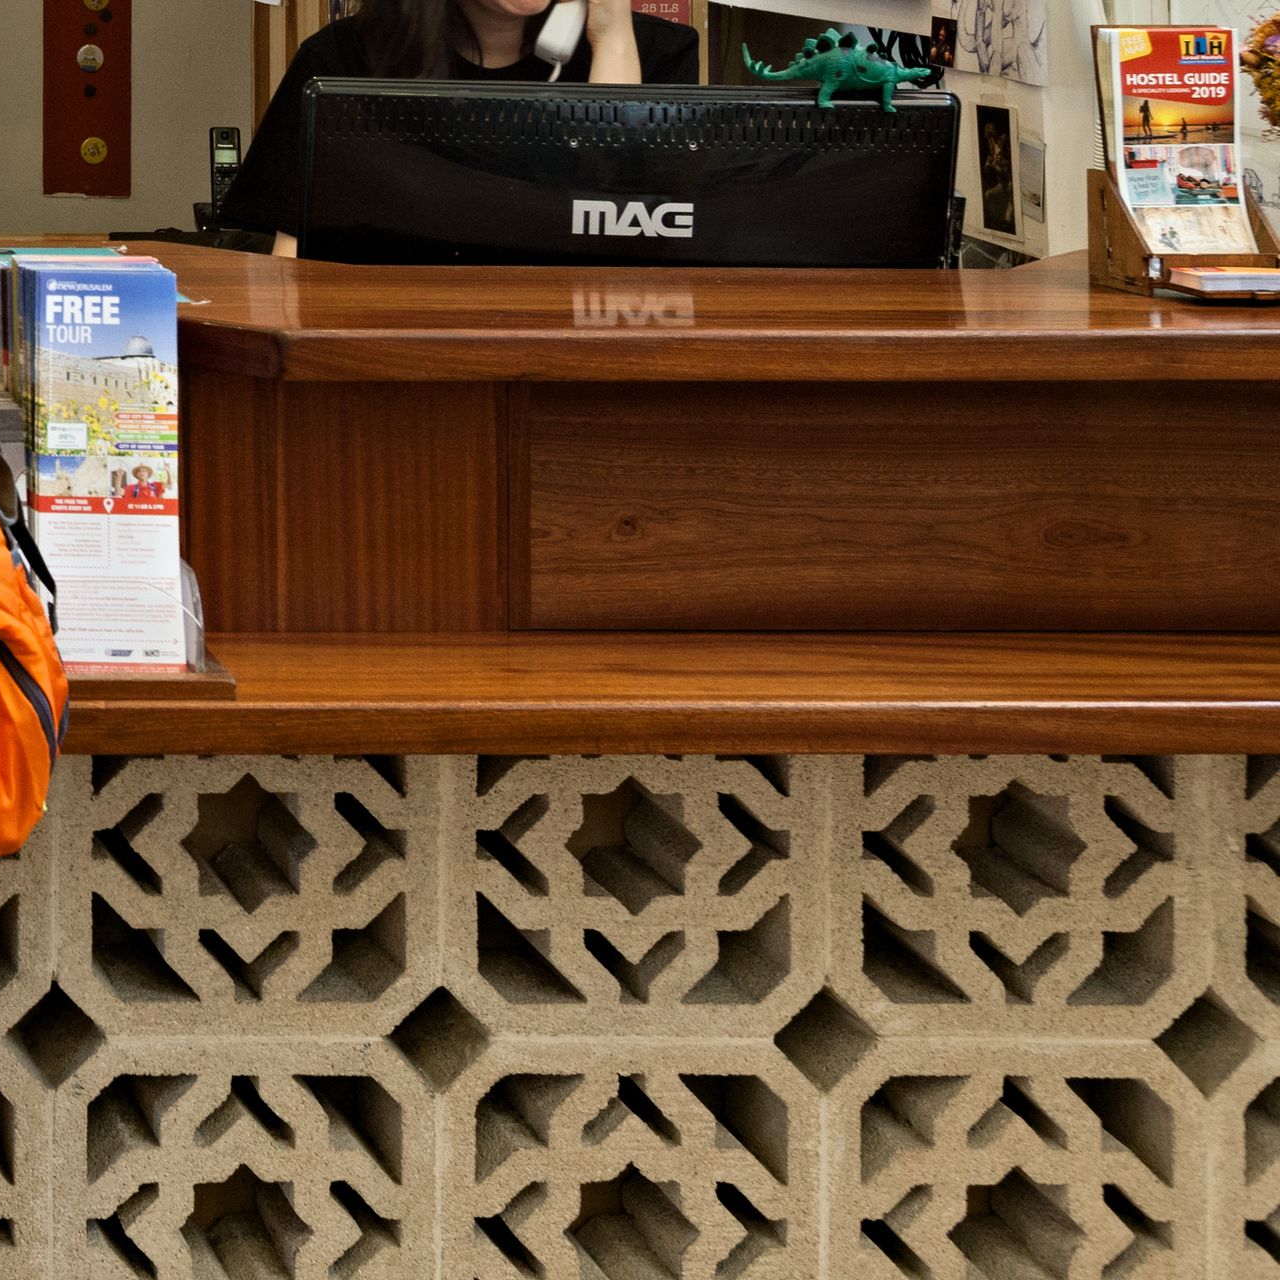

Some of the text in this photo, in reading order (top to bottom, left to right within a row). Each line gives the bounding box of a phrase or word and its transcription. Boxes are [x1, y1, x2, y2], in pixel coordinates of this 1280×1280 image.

[659, 3, 679, 13] ILS
[1126, 73, 1230, 85] HOSTEL GUIDE
[1191, 86, 1226, 98] 2019
[572, 199, 694, 238] MAG
[46, 295, 120, 324] FREE
[46, 325, 92, 344] TOUR
